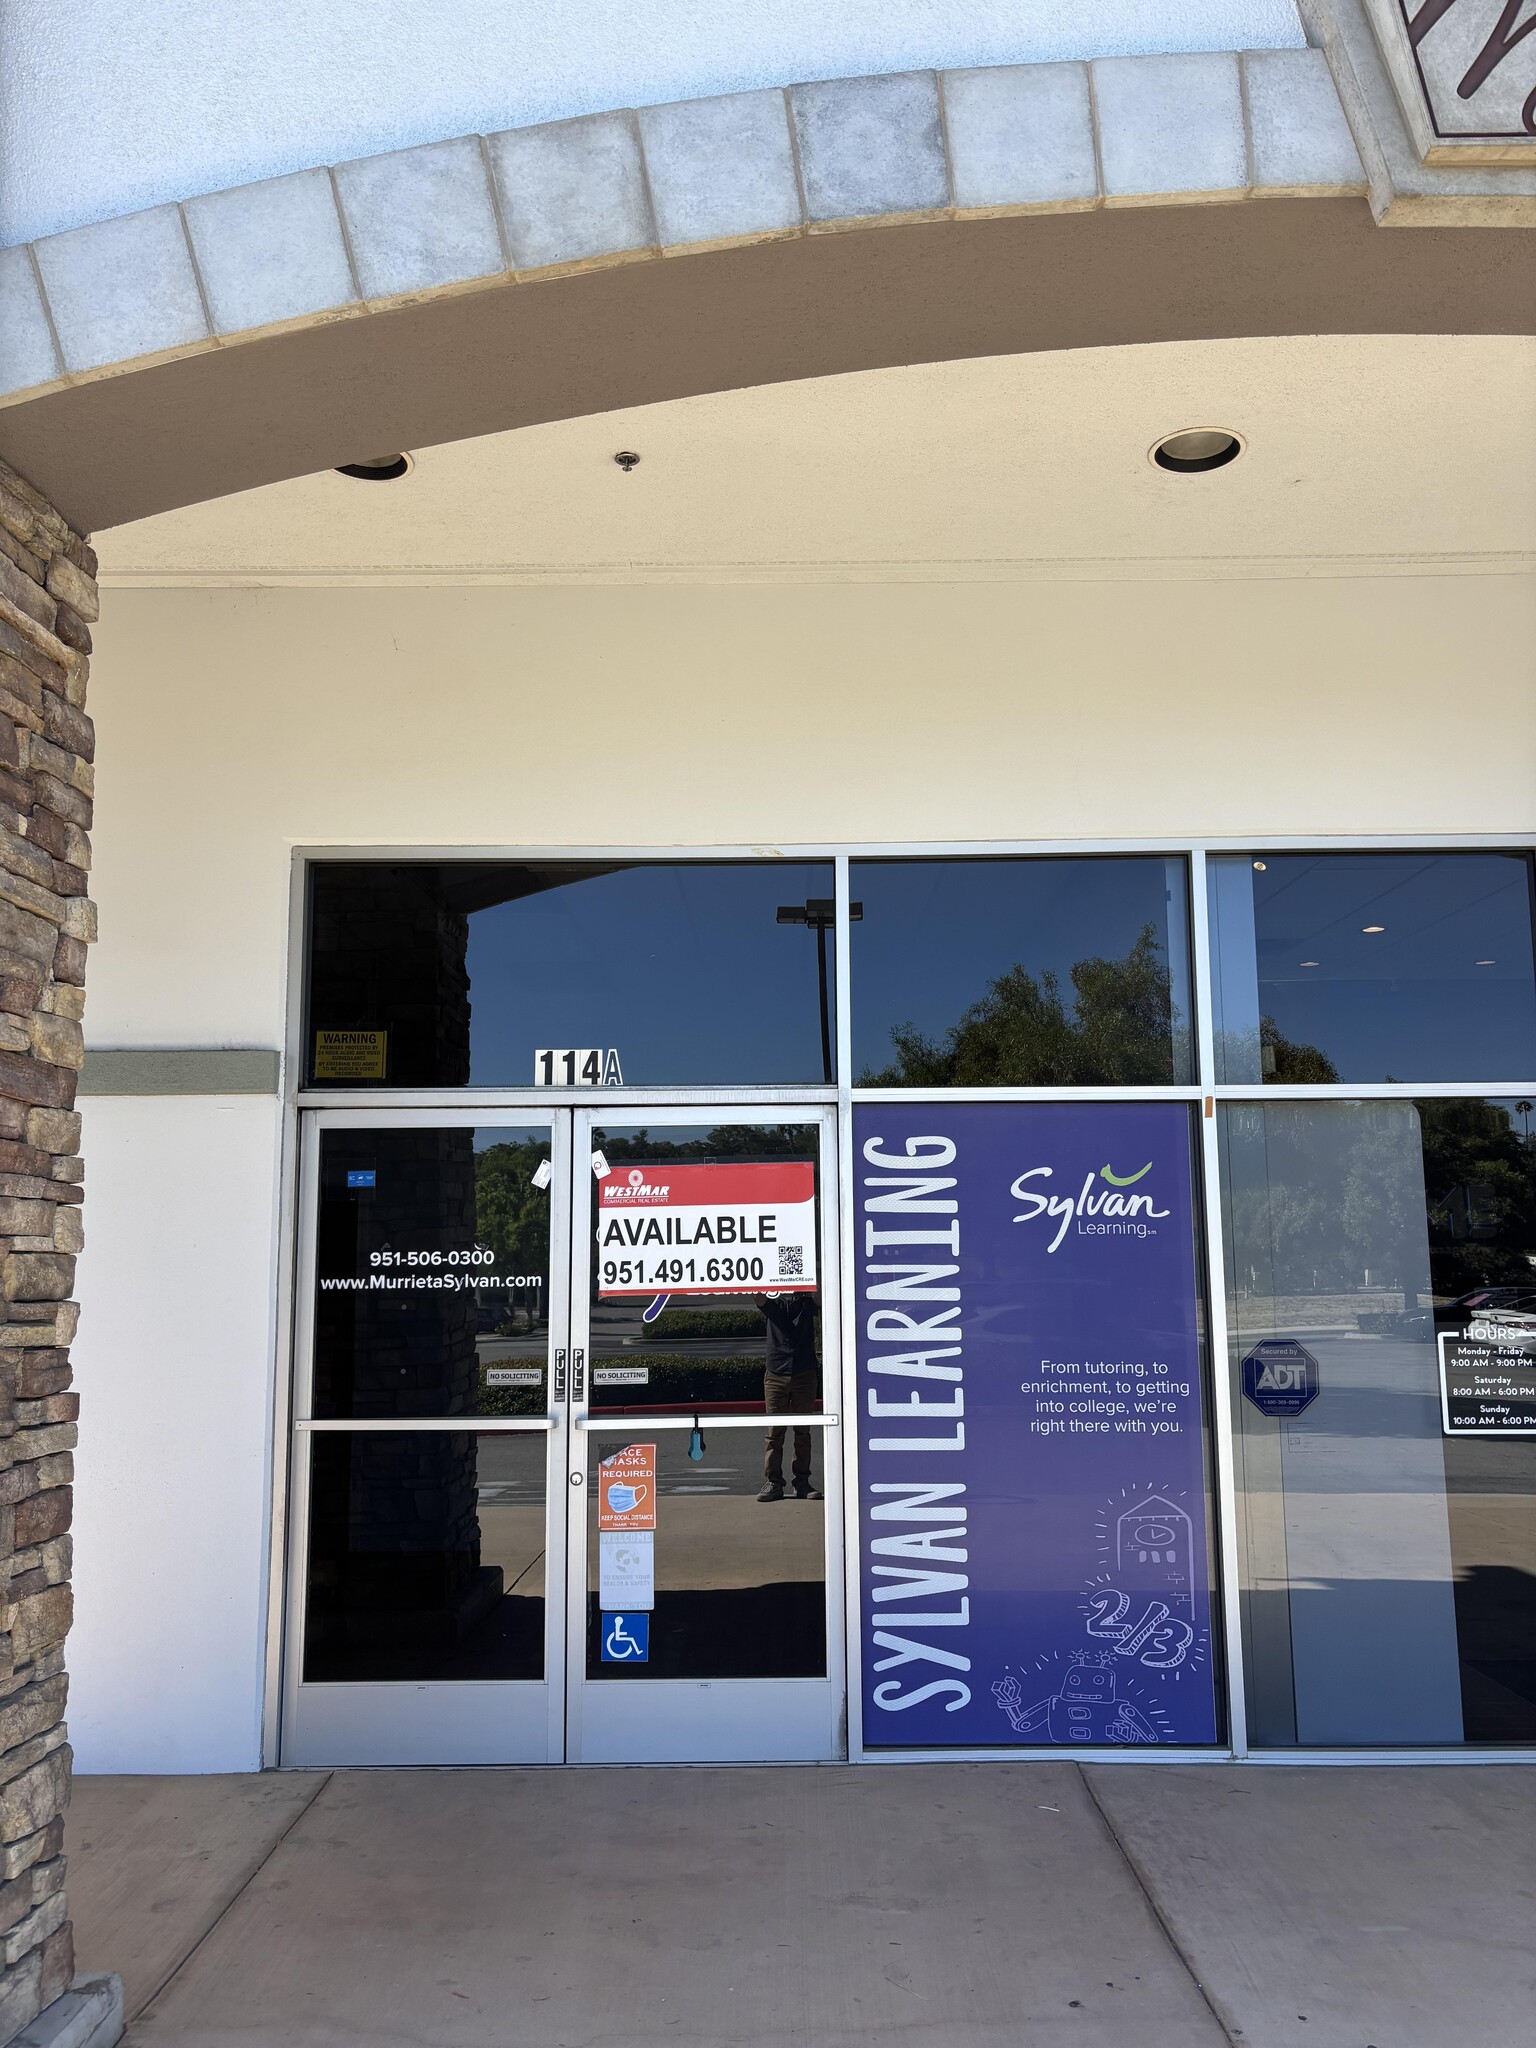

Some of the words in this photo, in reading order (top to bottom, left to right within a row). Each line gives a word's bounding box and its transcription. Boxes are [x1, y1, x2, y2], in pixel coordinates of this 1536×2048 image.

[323, 1033, 377, 1044] WARNING
[1010, 1166, 1171, 1254] Sylvan
[603, 1215, 777, 1247] AVAILABLE
[1078, 1221, 1146, 1239] Learning
[369, 1250, 495, 1267] 951-506-0300
[603, 1257, 764, 1285] 951.491.6300
[320, 1273, 542, 1291] www.MurrietaSylvan.com
[863, 1135, 965, 1451] LEARNING
[1463, 1328, 1516, 1340] HOURS
[1289, 1348, 1298, 1356] by
[1457, 1347, 1491, 1356] Monday
[1498, 1347, 1525, 1357] Friday
[556, 1350, 565, 1389] PULL
[574, 1350, 583, 1389] PULL
[1041, 1360, 1080, 1374] From
[1084, 1361, 1149, 1377] tutoring,
[1152, 1361, 1168, 1374] to
[1450, 1359, 1470, 1367] 9:00
[1472, 1359, 1489, 1367] AM
[1496, 1359, 1516, 1367] 9:00
[1517, 1359, 1533, 1367] PM
[607, 1371, 646, 1379] SOLICITING
[1256, 1364, 1306, 1390] ADT
[1474, 1375, 1512, 1386] Saturday
[1021, 1380, 1112, 1395] enrichment,
[1116, 1381, 1131, 1393] to
[1136, 1380, 1190, 1396] getting
[1452, 1387, 1472, 1396] 8:00
[1474, 1387, 1491, 1396] AM
[1498, 1387, 1518, 1396] 6:00
[1519, 1387, 1535, 1396] PM
[1036, 1400, 1065, 1413] into
[1069, 1399, 1130, 1416] college,
[1479, 1405, 1511, 1415] Sunday
[1030, 1419, 1065, 1435] right
[1069, 1419, 1110, 1433] there
[1114, 1419, 1146, 1433] with
[1151, 1421, 1183, 1435] you.
[1453, 1416, 1476, 1425] 10:00
[1478, 1416, 1495, 1425] AM
[1502, 1416, 1522, 1425] 6:00
[1523, 1416, 1536, 1425] PM
[620, 1448, 643, 1457] ACE
[614, 1457, 647, 1466] ASKS
[602, 1470, 653, 1478] REQUIRED
[601, 1532, 652, 1543] WELCOME
[870, 1483, 972, 1711] SYLVAN
[1087, 1588, 1194, 1668] 2/3
